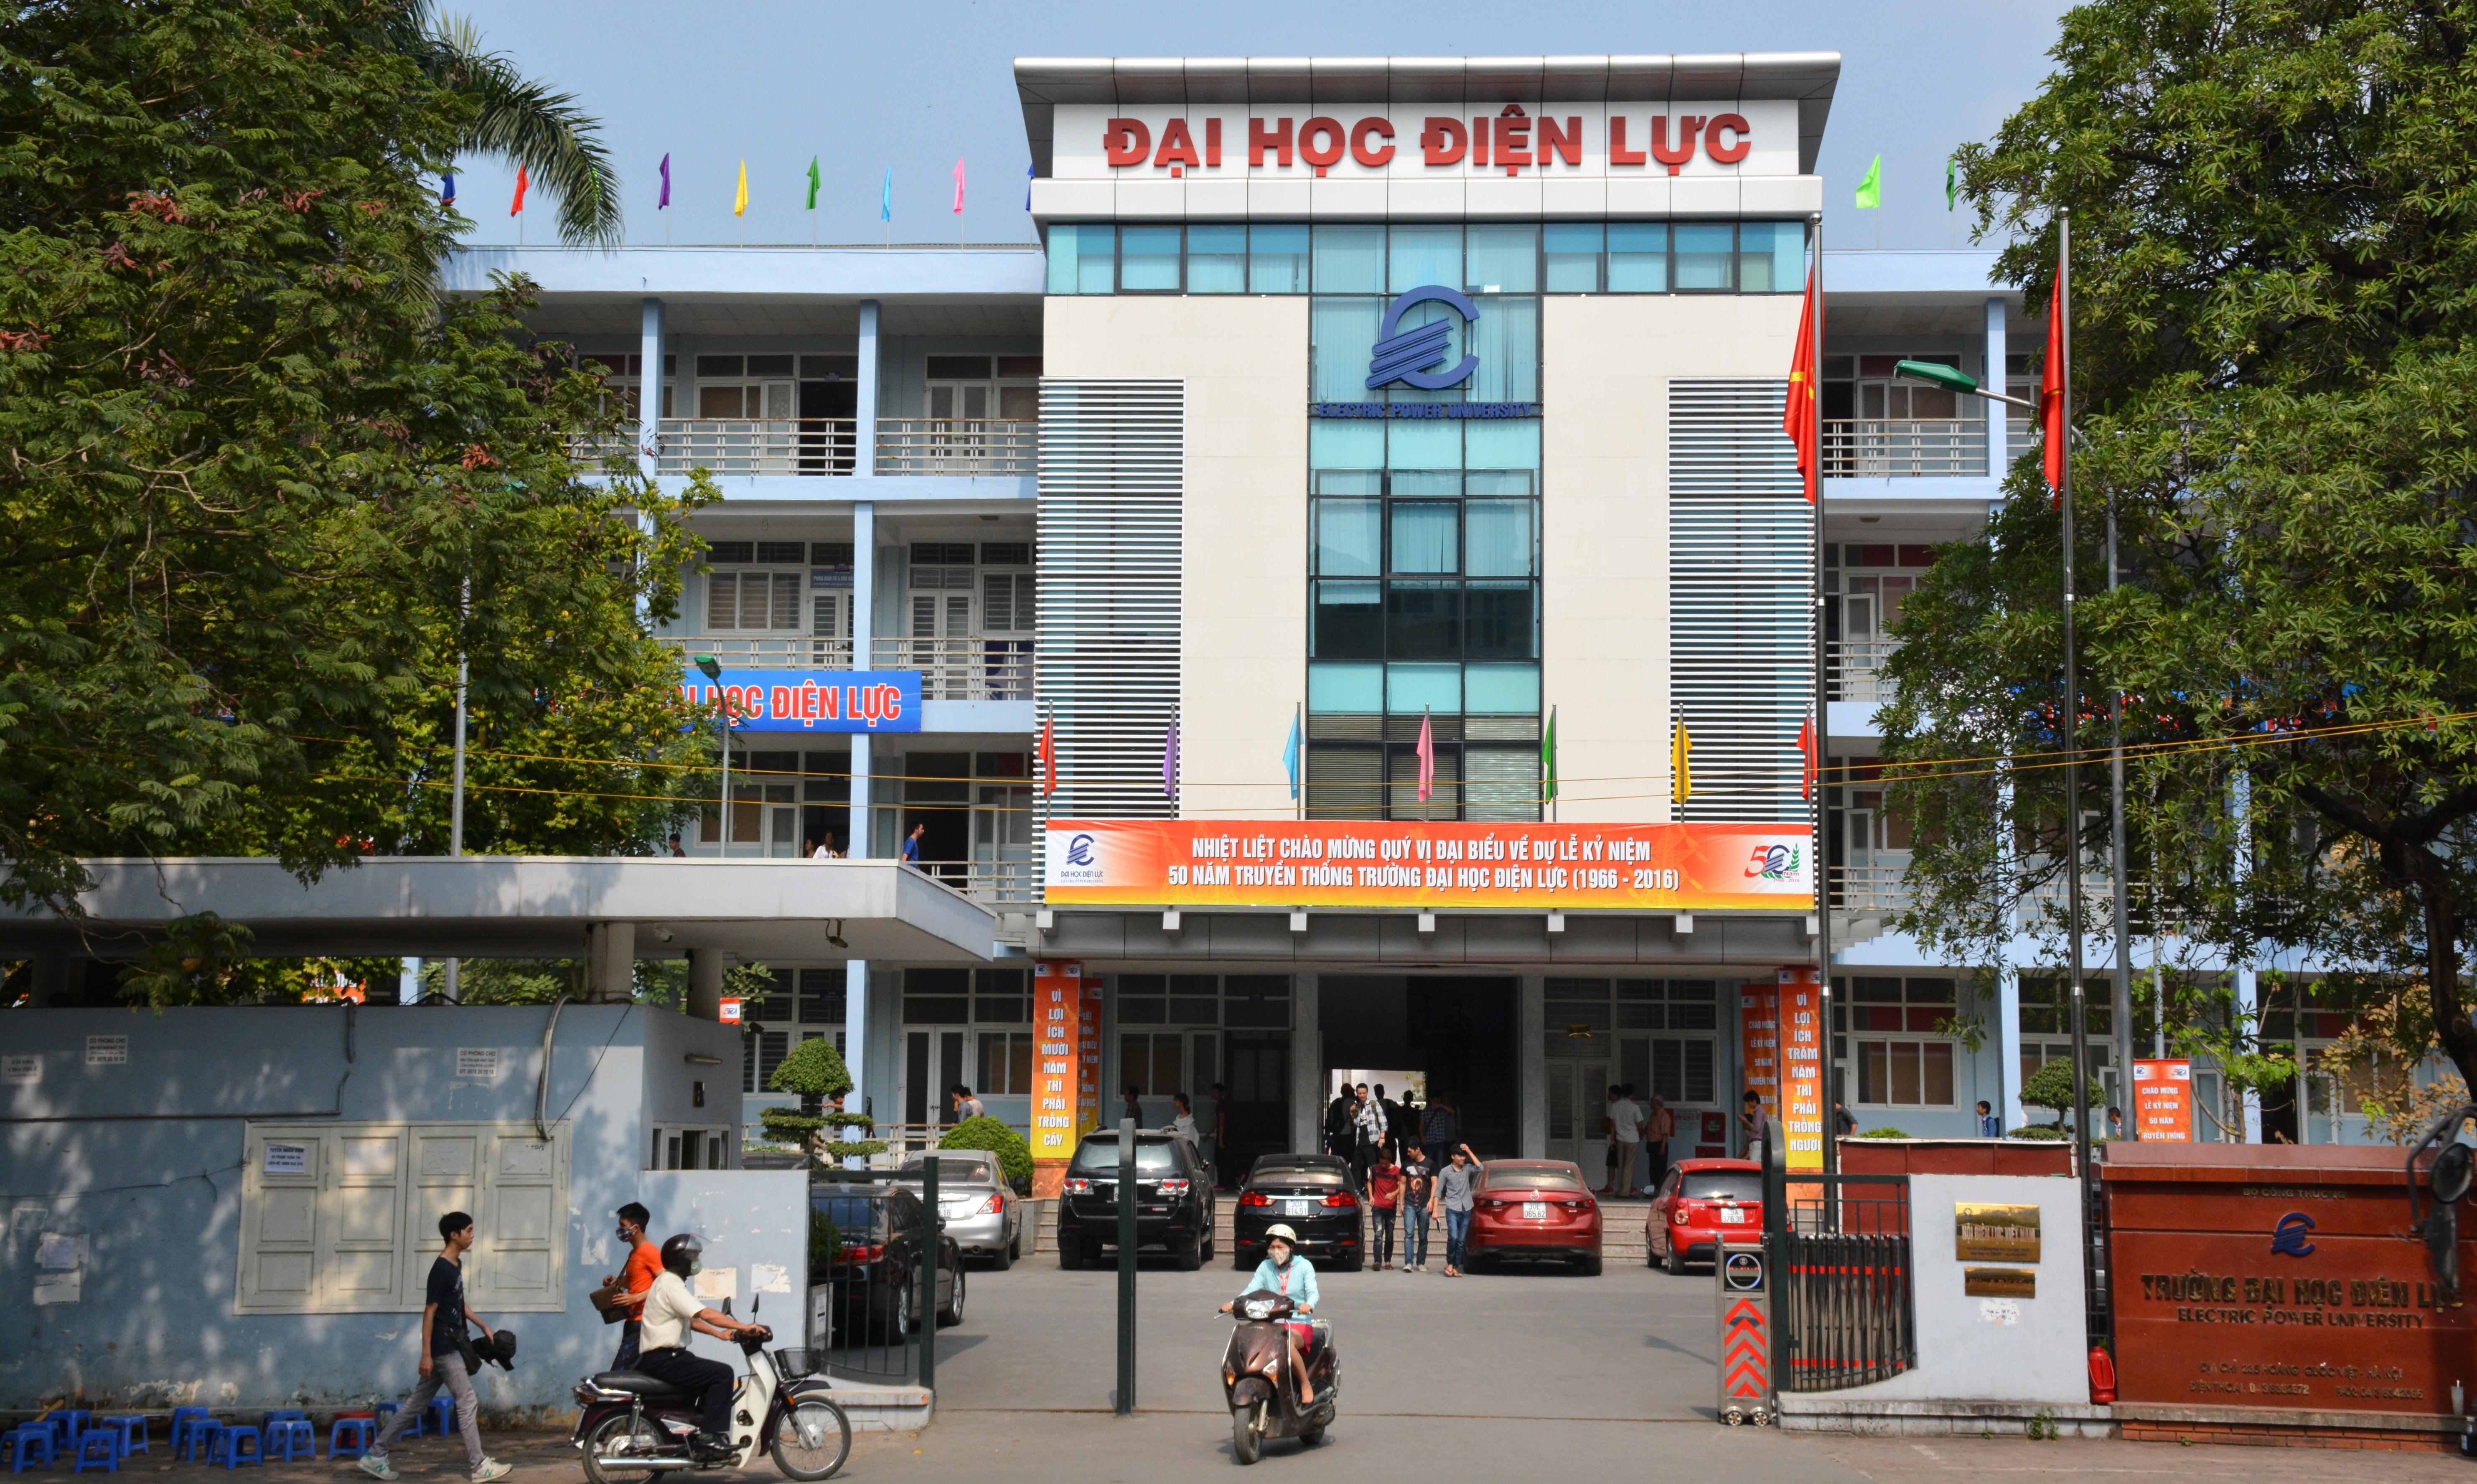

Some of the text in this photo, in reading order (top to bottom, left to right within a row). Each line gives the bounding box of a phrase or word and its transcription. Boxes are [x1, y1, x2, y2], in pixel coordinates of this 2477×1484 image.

[1103, 104, 1751, 177] ĐẠI HỌC ĐIỆN LỰC
[1320, 402, 1531, 418] ELECTRIC POWER UNIVERSITY
[706, 684, 764, 726] HỌC
[771, 679, 839, 727] ĐIỆN
[847, 683, 902, 727] LỰC
[1193, 833, 1651, 865] NHIỆT LIỆT CHÀO MỪNG QUÝ VỊ ĐẠI BIỂU VỀ DỰ LỄ KỶ NIỆM
[1168, 865, 1188, 885] 50
[1193, 861, 1230, 885] NĂM
[1235, 859, 1296, 886] TRUYỀN
[1300, 859, 1353, 886] THỐNG
[1358, 862, 1421, 887] TRƯỜNG
[1426, 867, 1453, 892] ĐẠI
[1458, 867, 1490, 892] HỌC
[1494, 864, 1533, 892] ĐIỆN
[1539, 867, 1567, 892] LỰC
[1573, 869, 1618, 891] (1966
[1634, 869, 1680, 891] 2016)
[1051, 989, 1062, 1002] VÌ
[1796, 992, 1808, 1006] VÌ
[1048, 1008, 1064, 1022] LỢI
[1794, 1011, 1810, 1024] LỢI
[1048, 1026, 1064, 1039] ÍCH
[1794, 1029, 1811, 1042] ÍCH
[1041, 1042, 1069, 1055] MƯỜI
[1787, 1047, 1818, 1060] TRĂM
[1043, 1061, 1067, 1075] NĂM
[1791, 1065, 1816, 1078] NĂM
[1046, 1078, 1062, 1092] THÌ
[1796, 1083, 1812, 1096] THÌ
[1043, 1095, 1066, 1110] PHẢI
[1793, 1100, 1817, 1115] PHẢI
[2163, 1101, 2178, 1110] NIỆM
[1044, 1132, 1063, 1146] CÂY
[2167, 1130, 2185, 1139] THỐNG
[1790, 1138, 1821, 1151] NGƯỜI
[2261, 1187, 2294, 1198] CÔNG
[2020, 1227, 2035, 1243] NAM
[2141, 1267, 2237, 1303] TRƯỜNG
[2244, 1276, 2285, 1309] ĐẠI
[2294, 1277, 2342, 1309] HỌC
[2177, 1306, 2424, 1328] ELECTRIC POWER UNIVERSITY
[2262, 1362, 2300, 1376] HOÀNG
[2304, 1362, 2335, 1377] QUỐC
[2337, 1365, 2358, 1380] VIỆT
[2366, 1365, 2382, 1379] HÀ
[2384, 1366, 2403, 1381] NỘI
